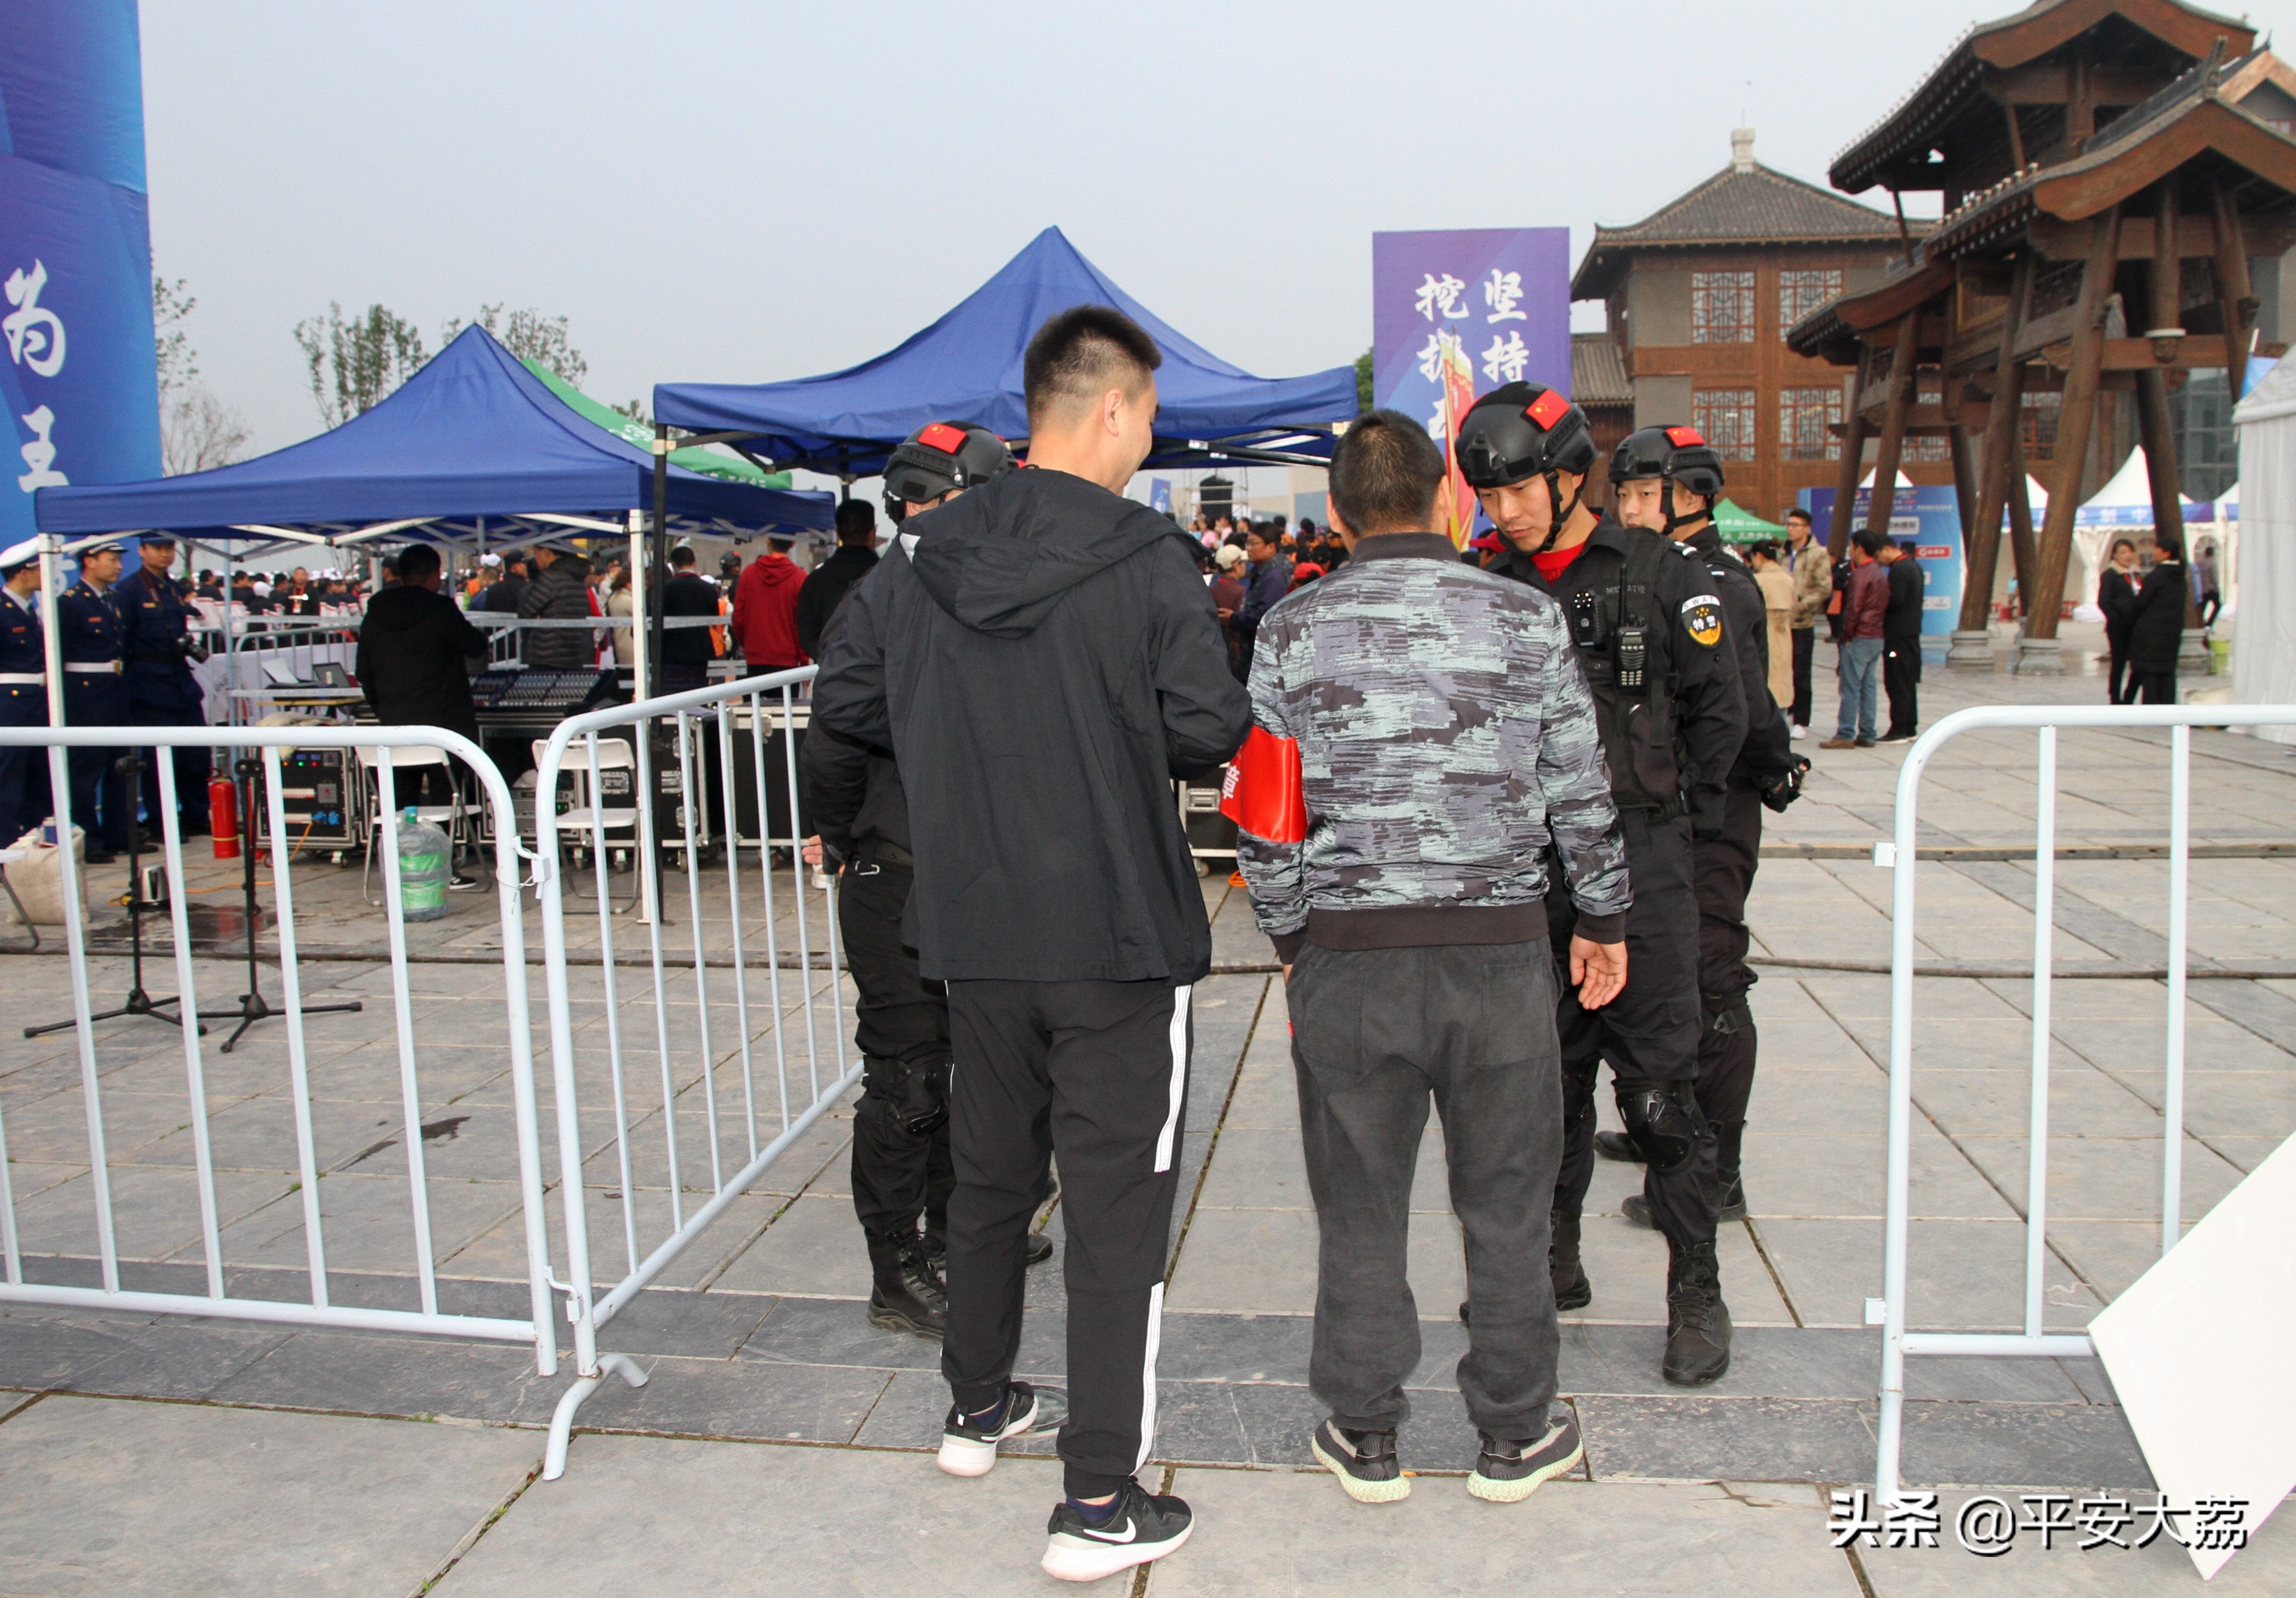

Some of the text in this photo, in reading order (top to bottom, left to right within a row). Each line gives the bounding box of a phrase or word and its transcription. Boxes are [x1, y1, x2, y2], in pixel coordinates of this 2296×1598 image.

[1481, 268, 1530, 383] 坚持
[1683, 596, 1714, 610] SWAT
[1693, 615, 1716, 631] 特警
